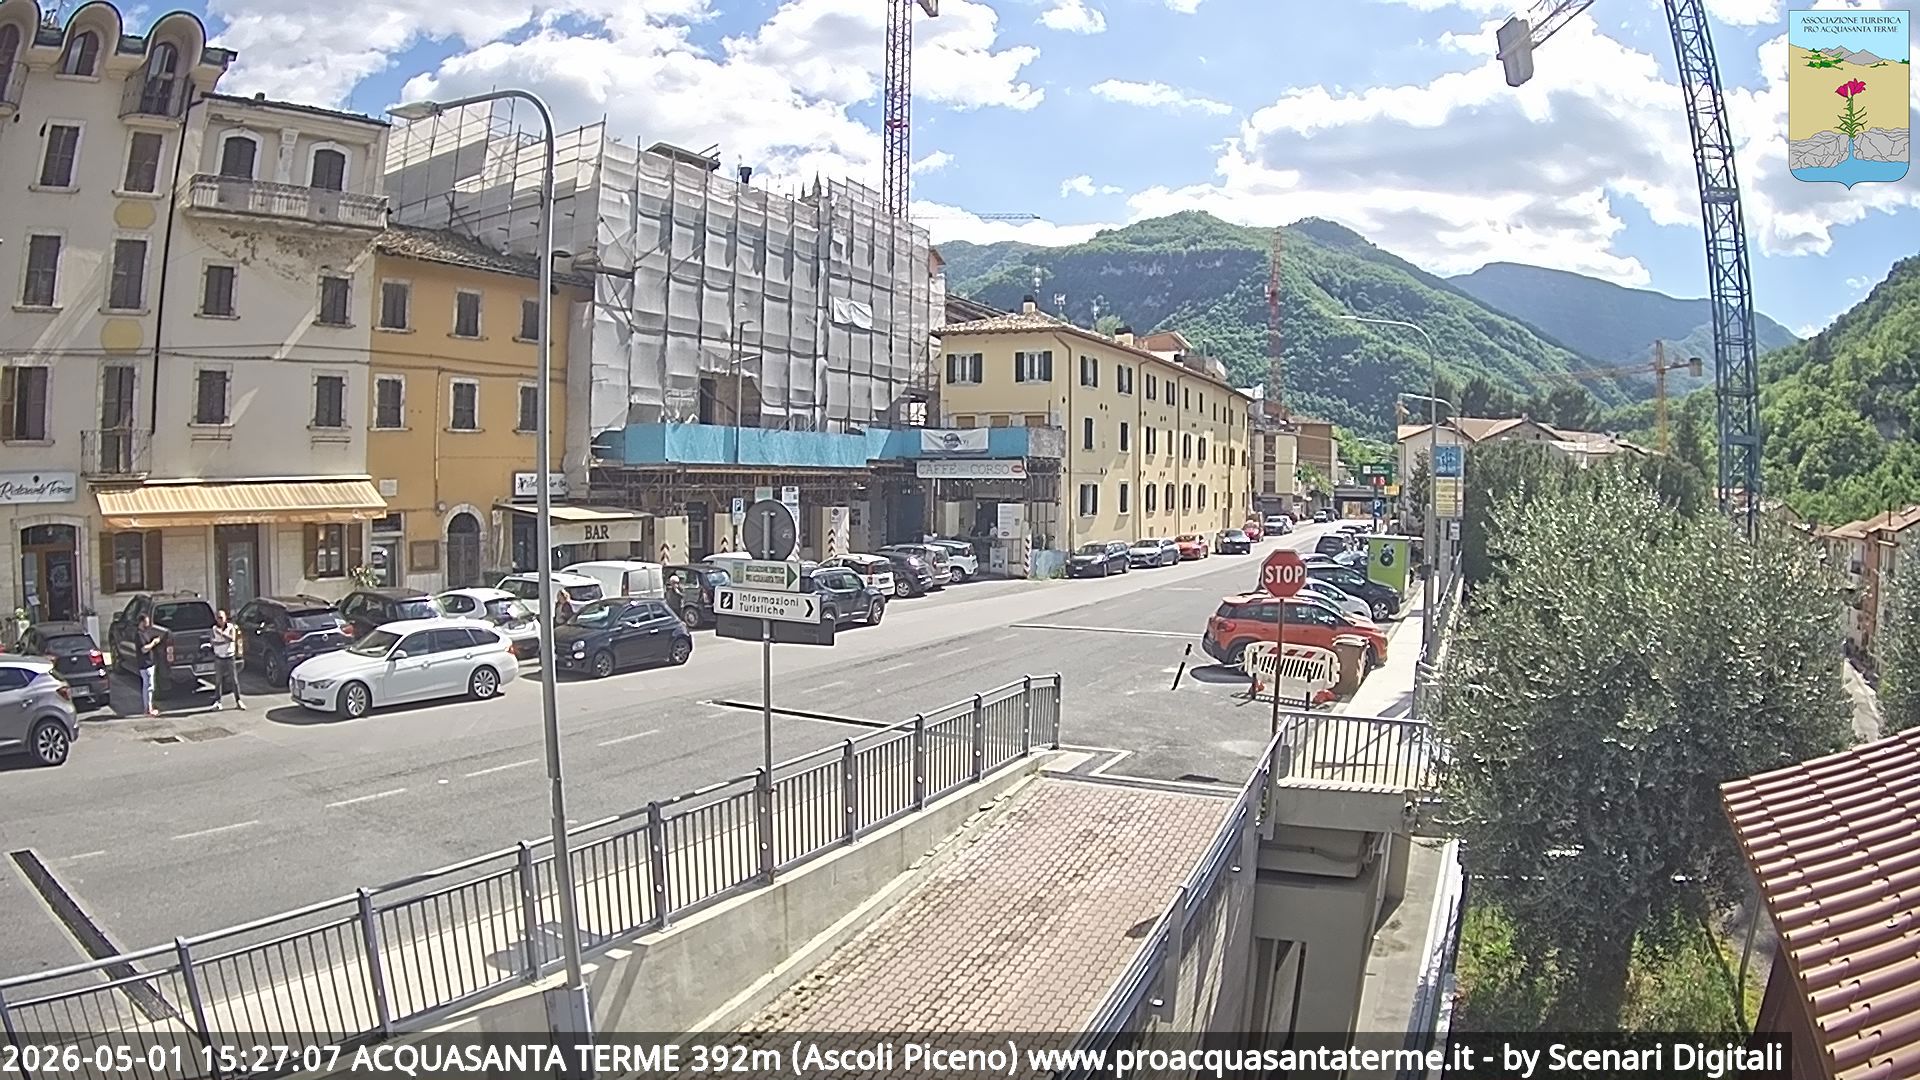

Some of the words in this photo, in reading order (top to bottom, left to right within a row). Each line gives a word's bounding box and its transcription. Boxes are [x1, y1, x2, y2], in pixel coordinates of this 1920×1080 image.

[970, 464, 1010, 475] CORSO
[584, 524, 610, 541] BAR
[1265, 565, 1304, 584] STOP
[740, 593, 799, 607] Informazioni
[740, 602, 785, 616] Turistiche
